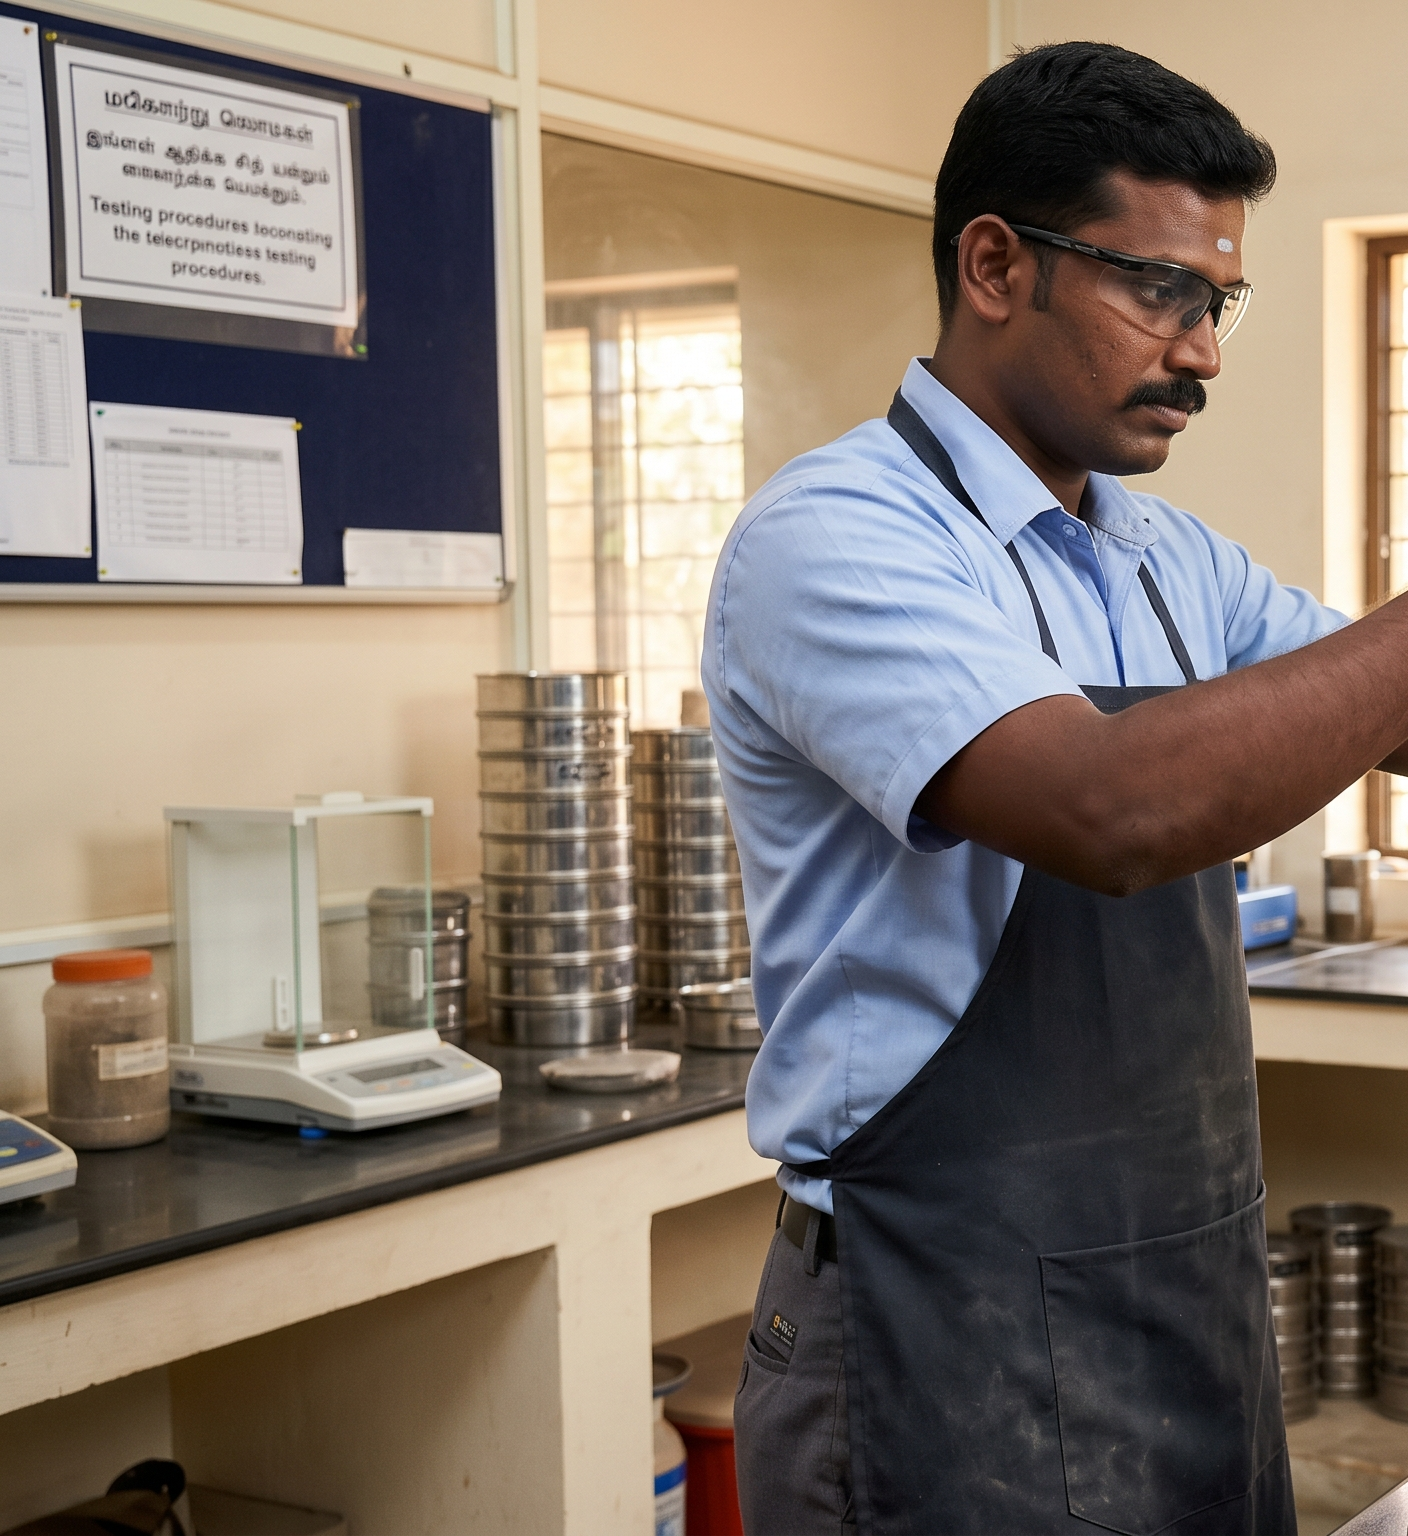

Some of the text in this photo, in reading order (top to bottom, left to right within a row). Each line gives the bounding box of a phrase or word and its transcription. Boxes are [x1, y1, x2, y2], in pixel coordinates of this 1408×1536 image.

[90, 195, 153, 224] Testing
[158, 205, 250, 234] procedures
[113, 225, 141, 244] the
[266, 245, 316, 271] testing
[171, 260, 267, 286] procedures.
